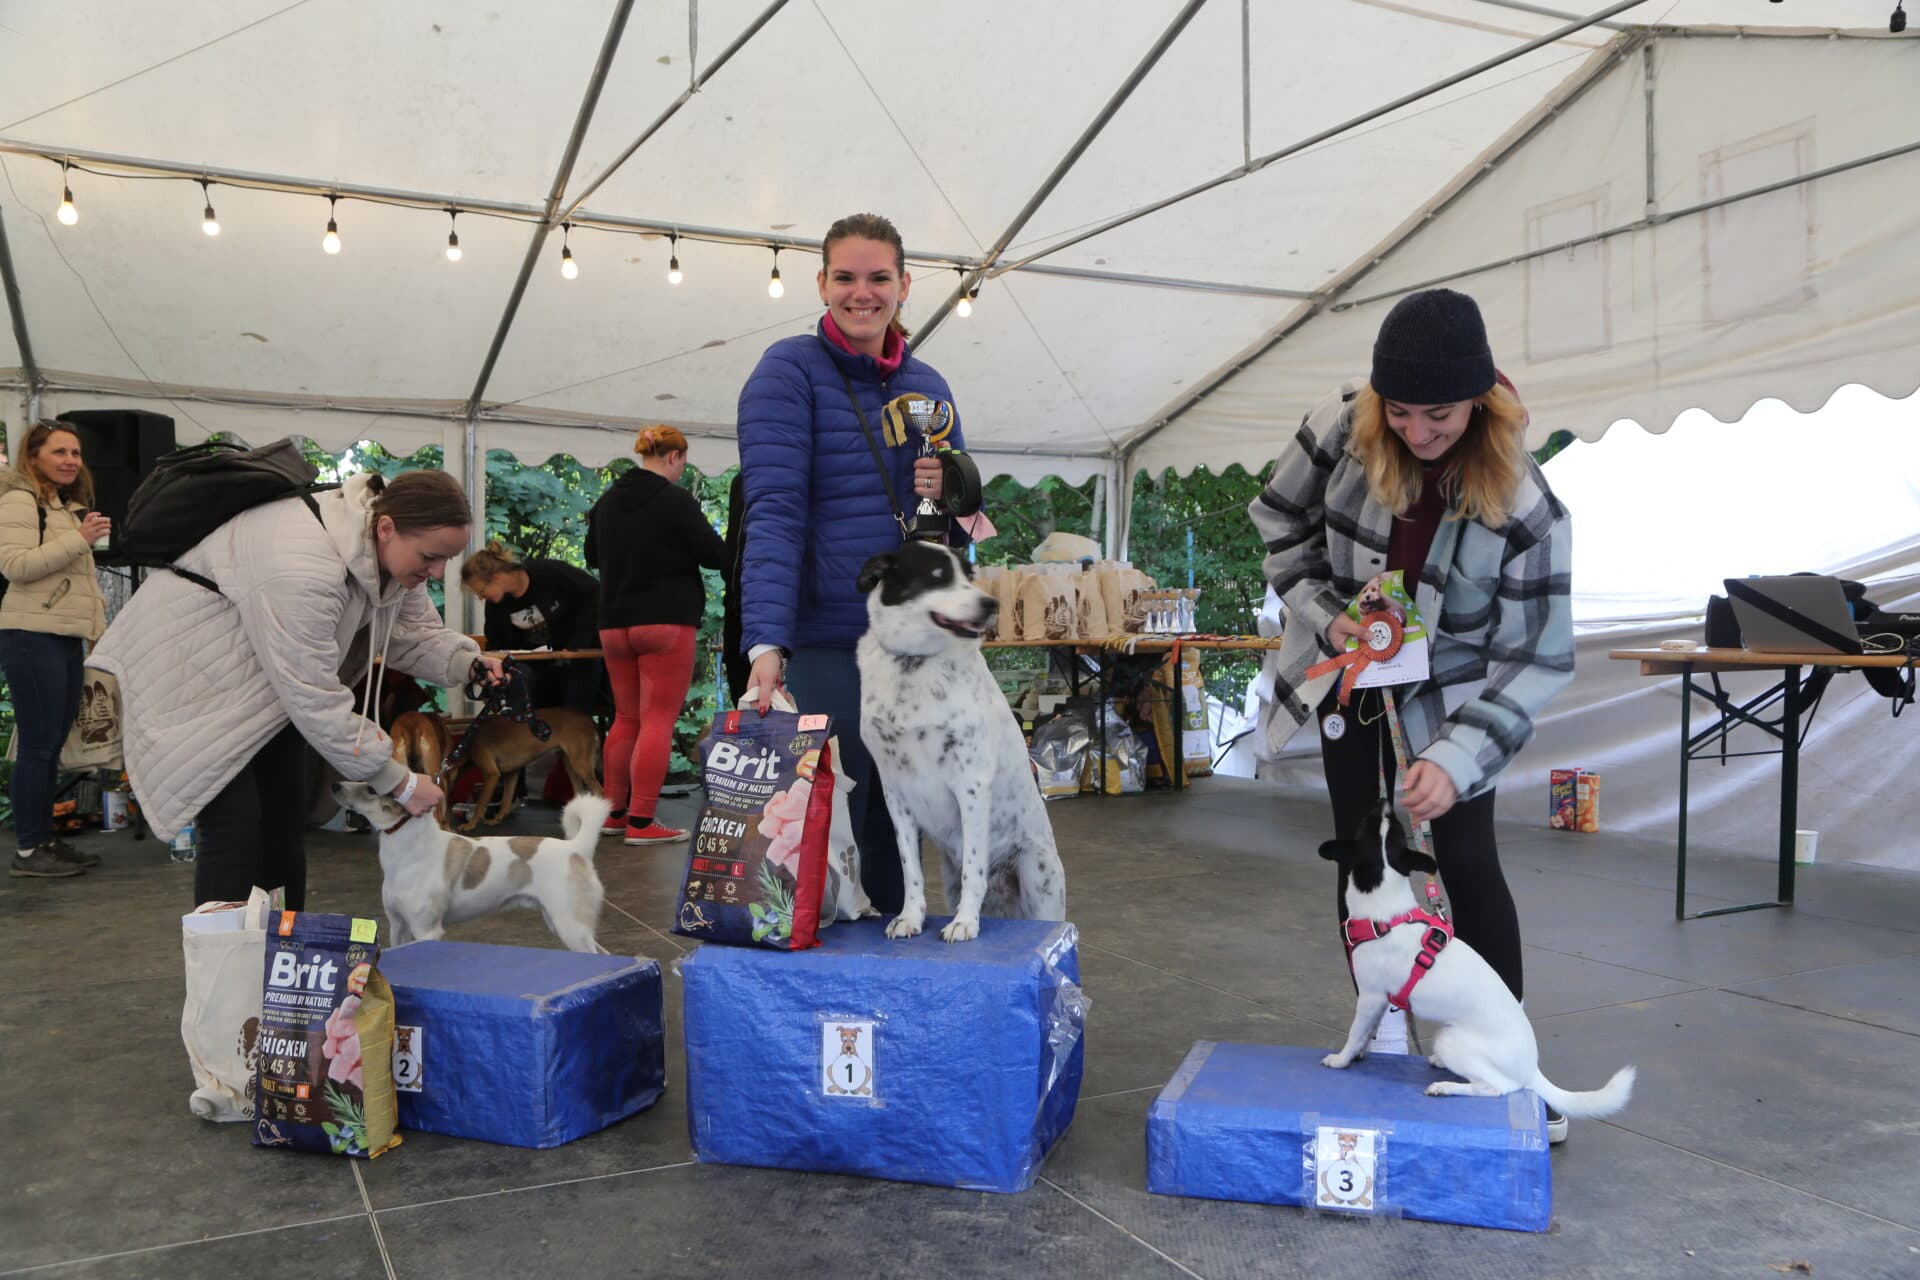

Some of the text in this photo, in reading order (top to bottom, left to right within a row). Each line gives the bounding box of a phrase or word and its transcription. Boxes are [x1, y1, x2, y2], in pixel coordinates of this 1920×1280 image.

[706, 741, 781, 780] Brit
[705, 773, 776, 795] PREMIUM BY NATURE
[700, 816, 747, 838] CHICKEN
[706, 837, 728, 854] 45 %
[734, 864, 740, 875] L
[268, 951, 339, 991] Brit
[264, 991, 298, 1004] PREMIUM
[304, 995, 334, 1008] NATURE
[262, 1036, 308, 1058] HICKEN
[270, 1058, 296, 1076] 45 %
[399, 1059, 410, 1077] 2
[845, 1063, 853, 1083] 1
[1338, 1170, 1354, 1192] 3
